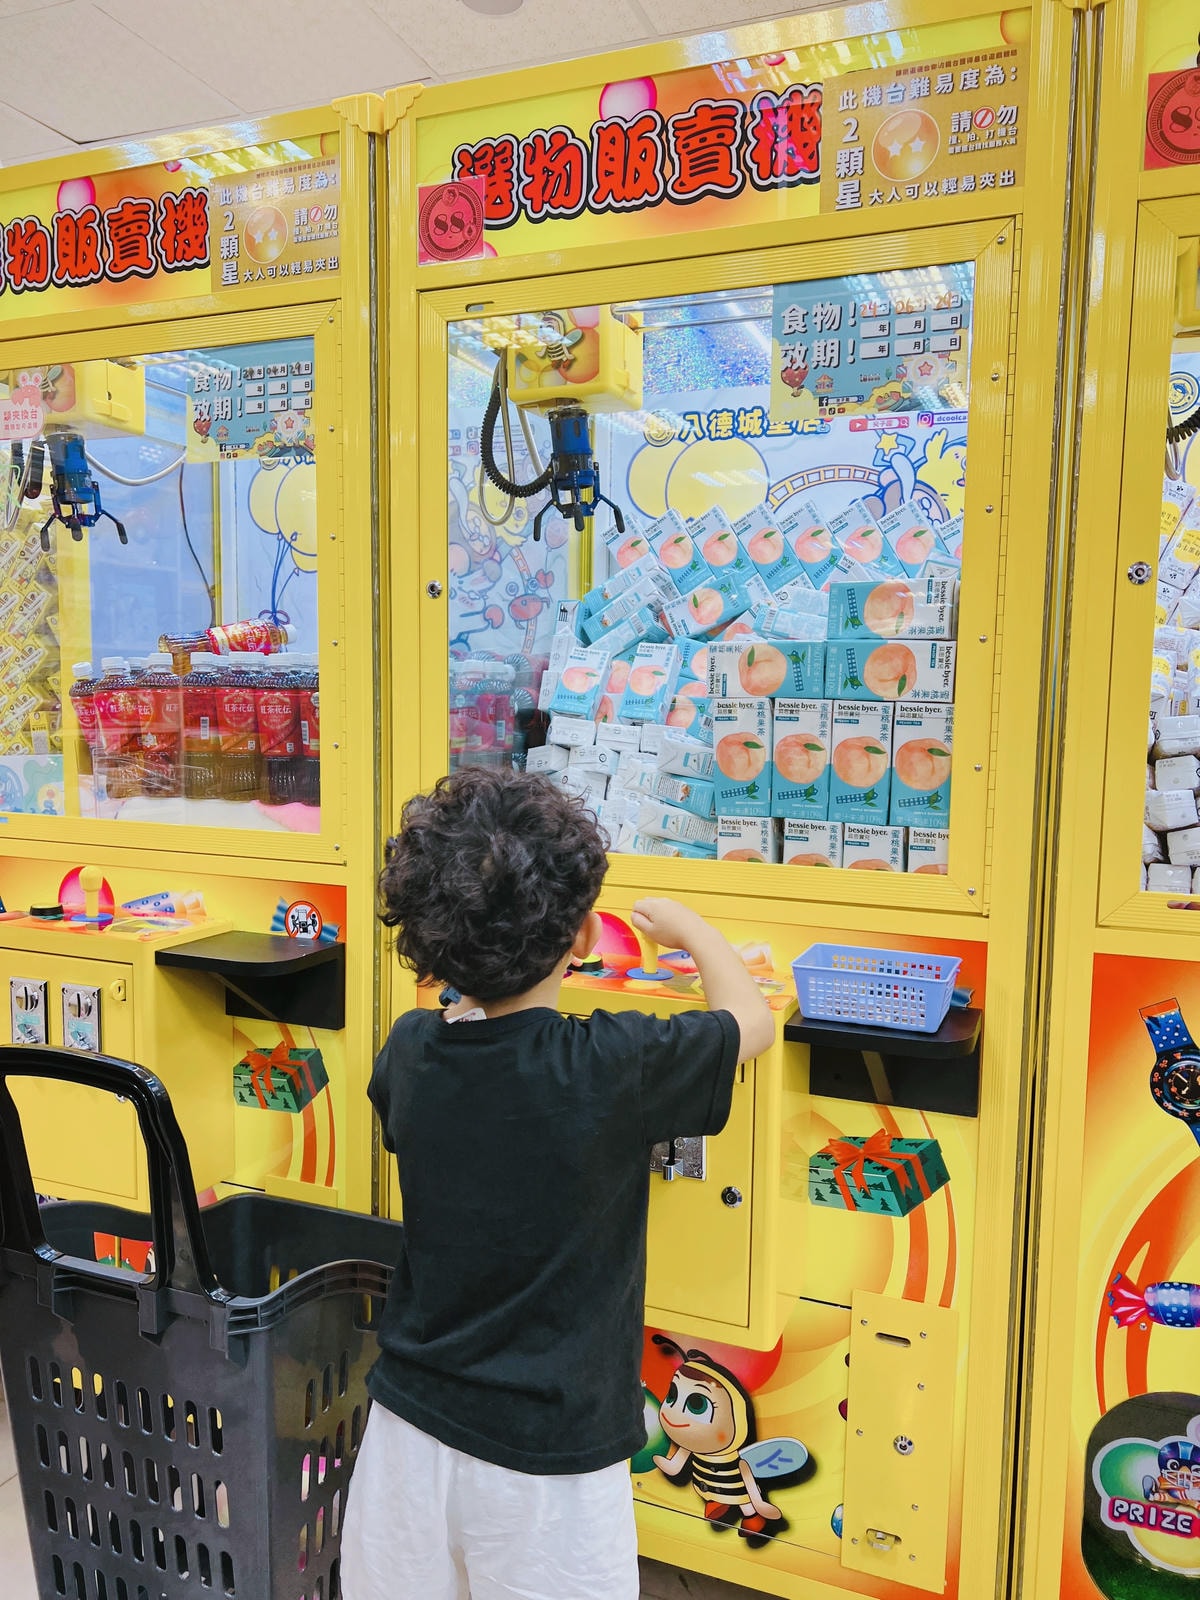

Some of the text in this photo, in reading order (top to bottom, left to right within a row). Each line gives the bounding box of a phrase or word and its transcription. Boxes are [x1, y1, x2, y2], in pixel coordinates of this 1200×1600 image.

[452, 82, 822, 230] 選物販賣機
[868, 169, 1016, 206] 大人可以輕易夾出
[0, 186, 211, 296] 物販賣機
[243, 256, 339, 282] 大人可以輕易夾出
[838, 703, 860, 711] bessie
[787, 821, 809, 829] bessie
[848, 826, 888, 836] bessie byer.
[913, 830, 937, 839] bessie
[1113, 1499, 1193, 1534] PRIZE
